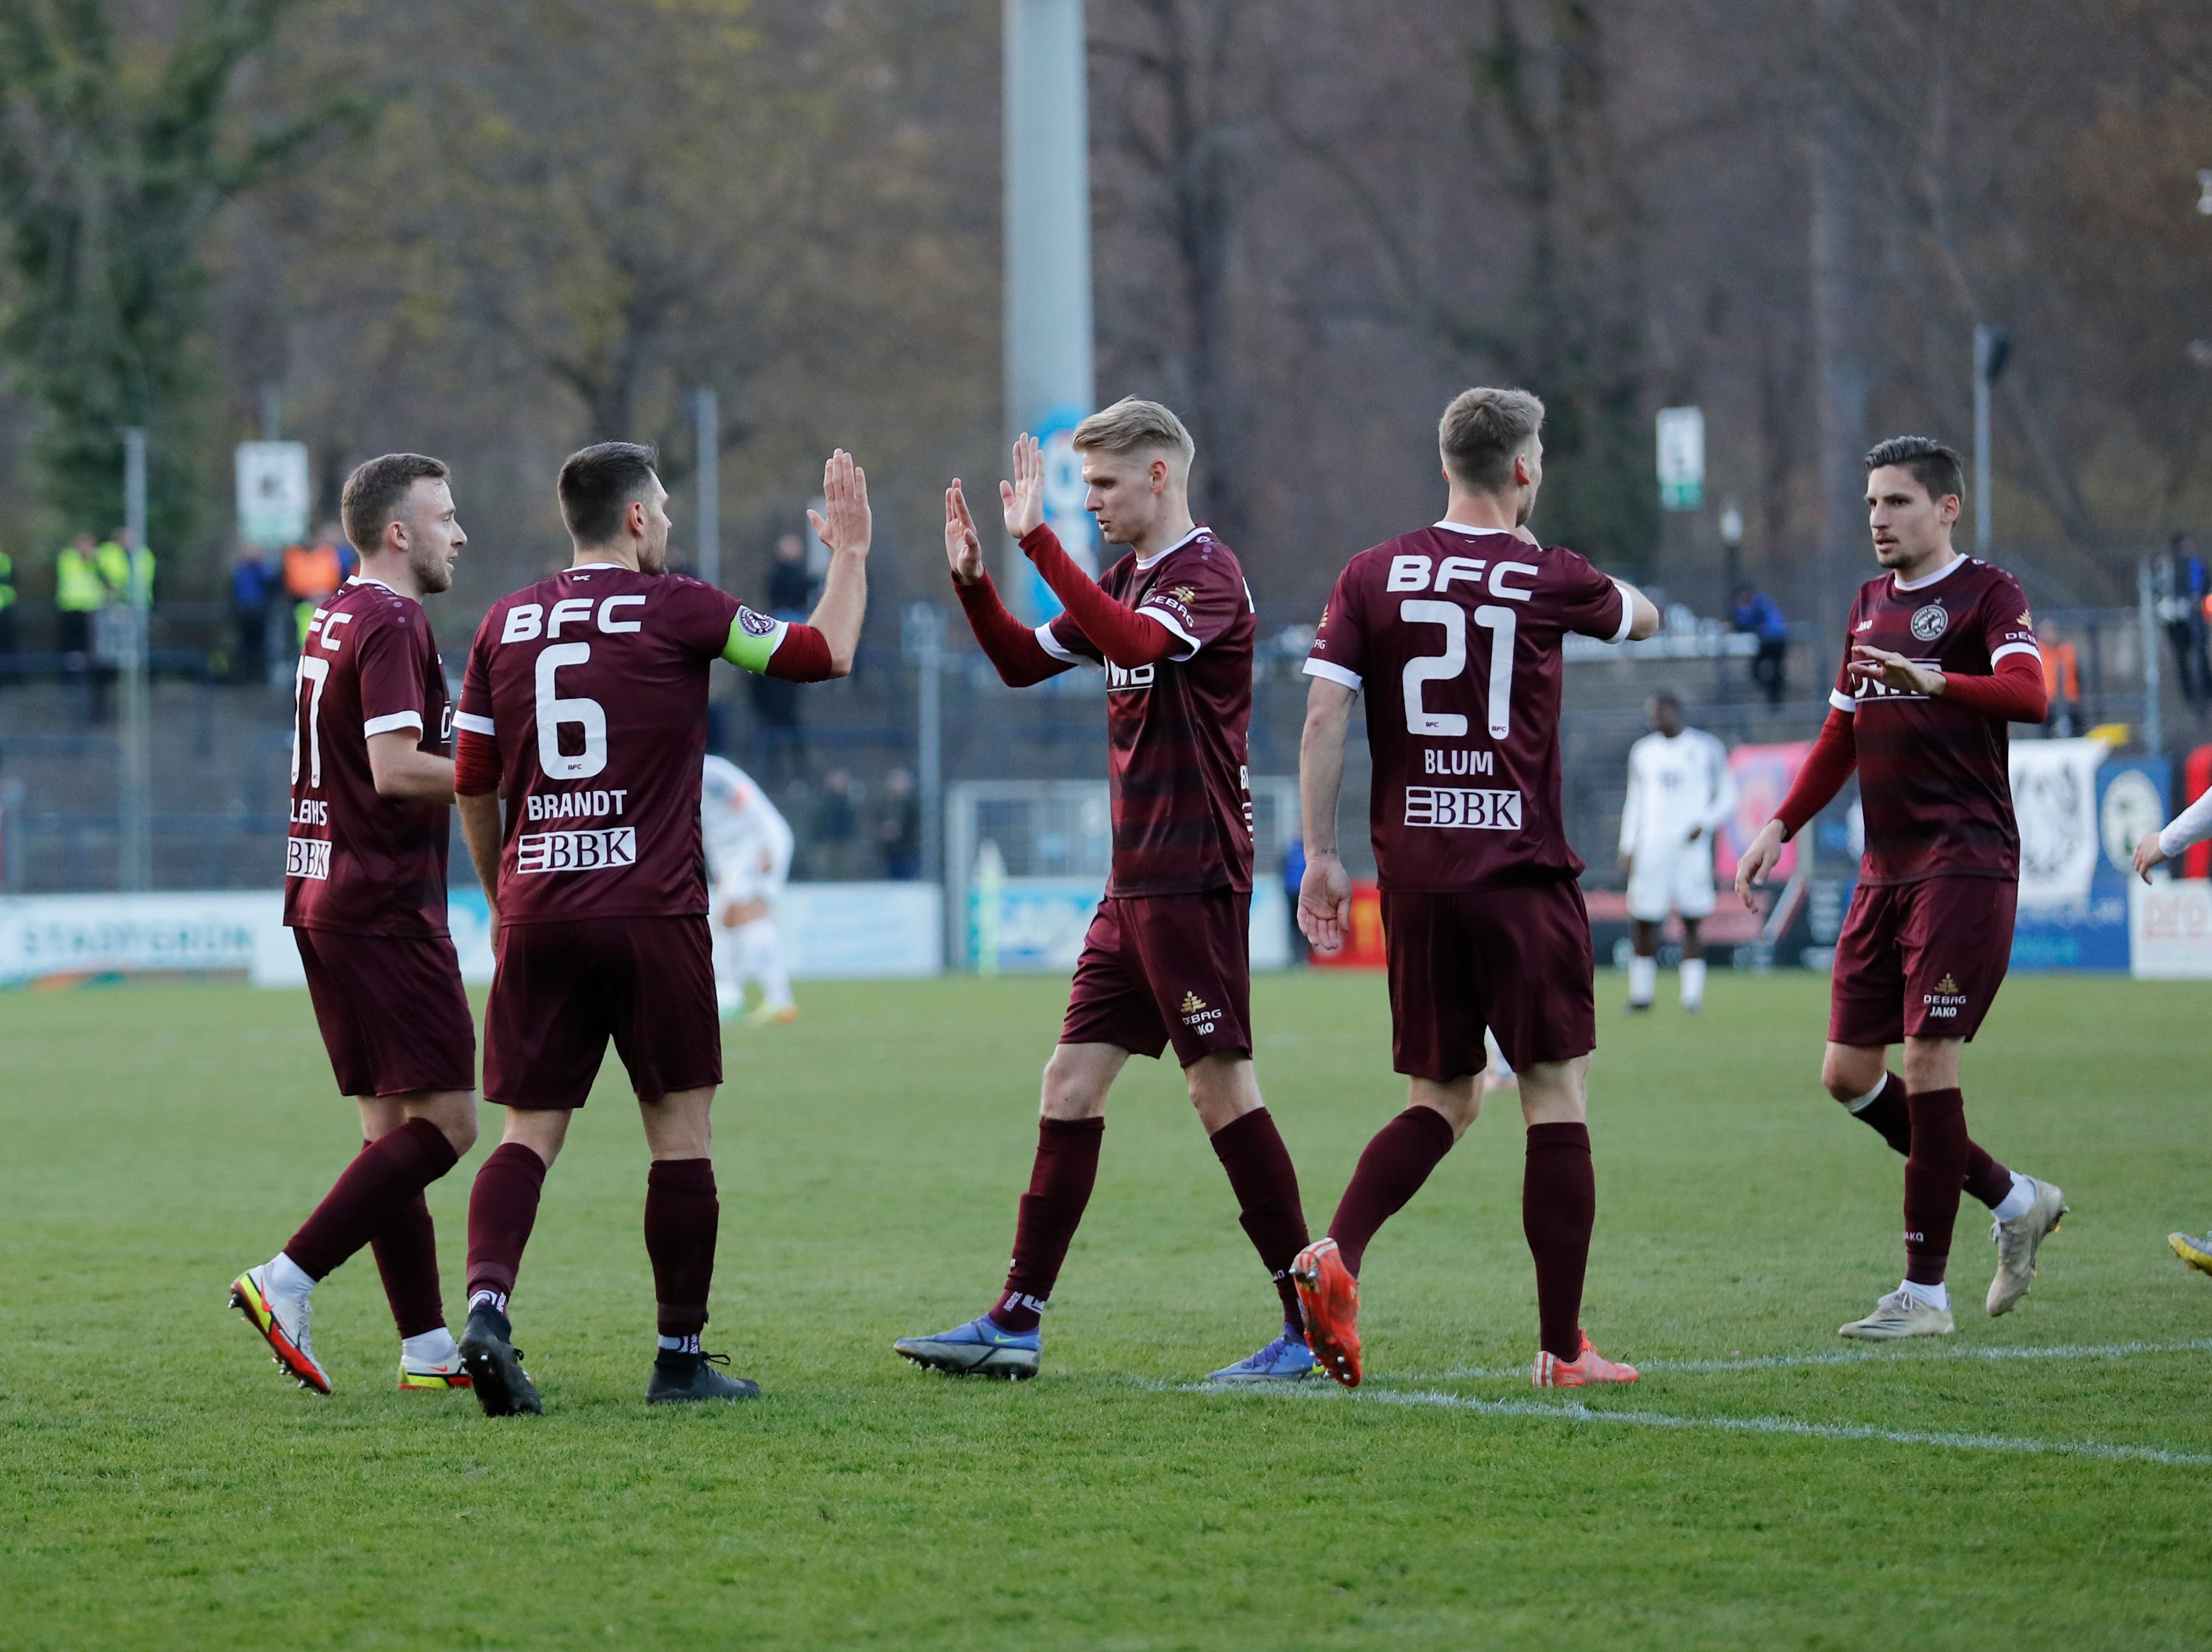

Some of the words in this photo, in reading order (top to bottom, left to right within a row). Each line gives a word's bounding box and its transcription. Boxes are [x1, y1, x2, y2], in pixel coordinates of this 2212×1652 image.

[1386, 554, 1539, 602] BFC
[500, 595, 647, 644] BFC
[1400, 599, 1517, 740] 21
[535, 642, 607, 780] 6
[1424, 749, 1493, 776] BLUM
[527, 790, 627, 820] BRANDT
[1431, 790, 1520, 828] BBK
[287, 841, 329, 877] BBK
[548, 829, 635, 869] BBK
[1923, 994, 1966, 1005] DEBAG
[1929, 1006, 1958, 1017] JAKO
